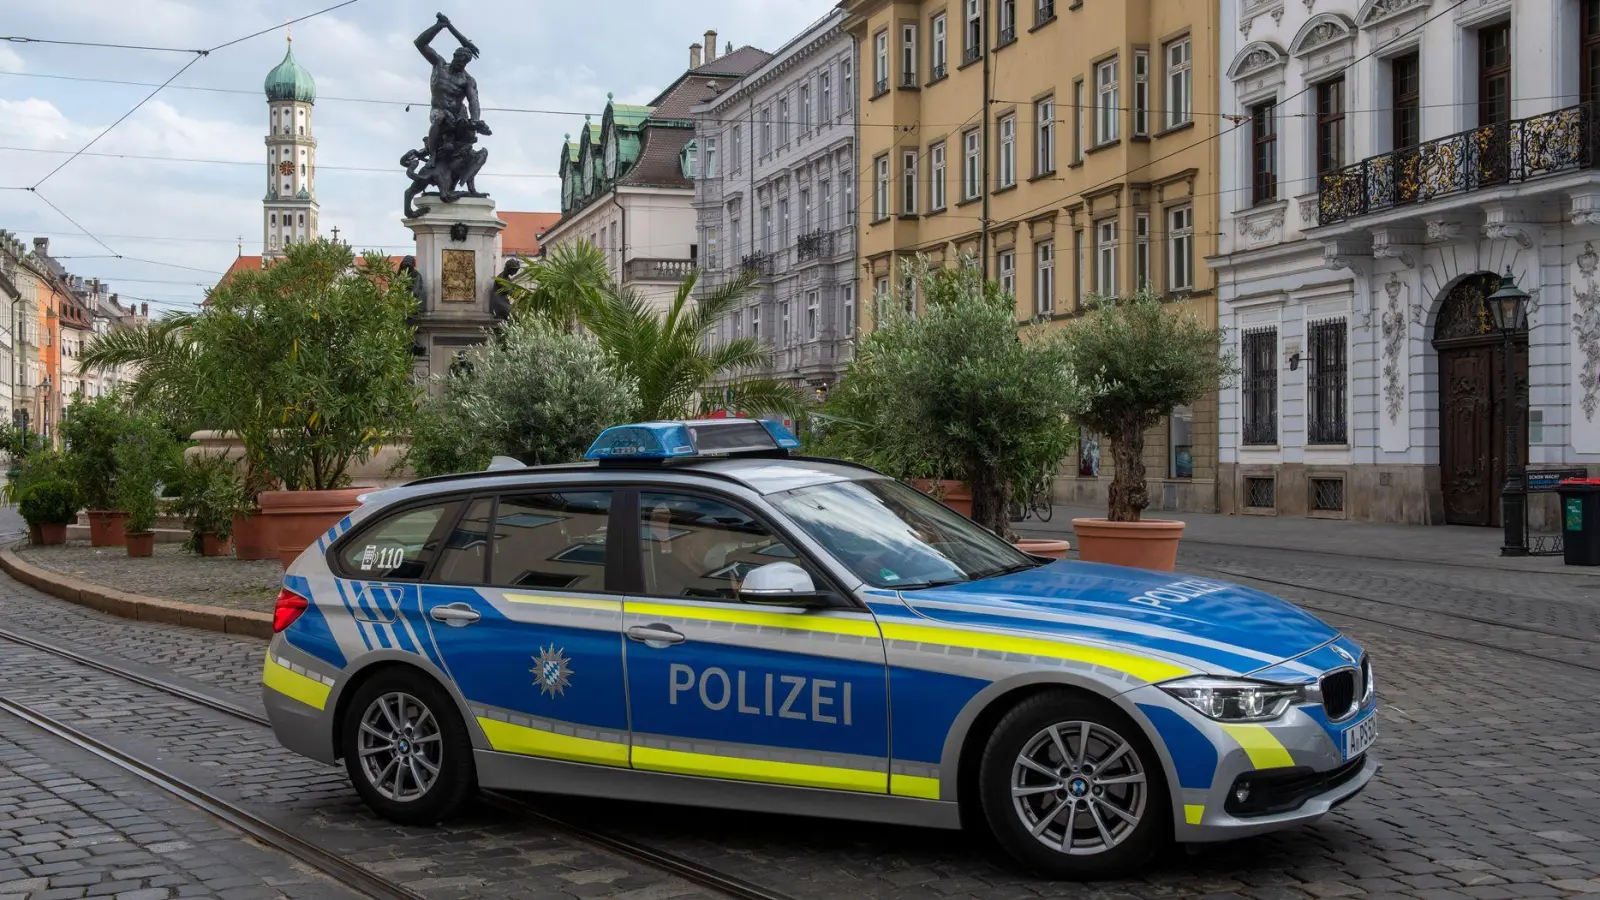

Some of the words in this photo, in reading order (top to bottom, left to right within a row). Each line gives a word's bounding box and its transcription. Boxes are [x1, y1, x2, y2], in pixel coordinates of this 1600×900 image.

[377, 547, 405, 569] 110
[1128, 579, 1231, 611] POLIZEI
[669, 663, 852, 726] POLIZEI
